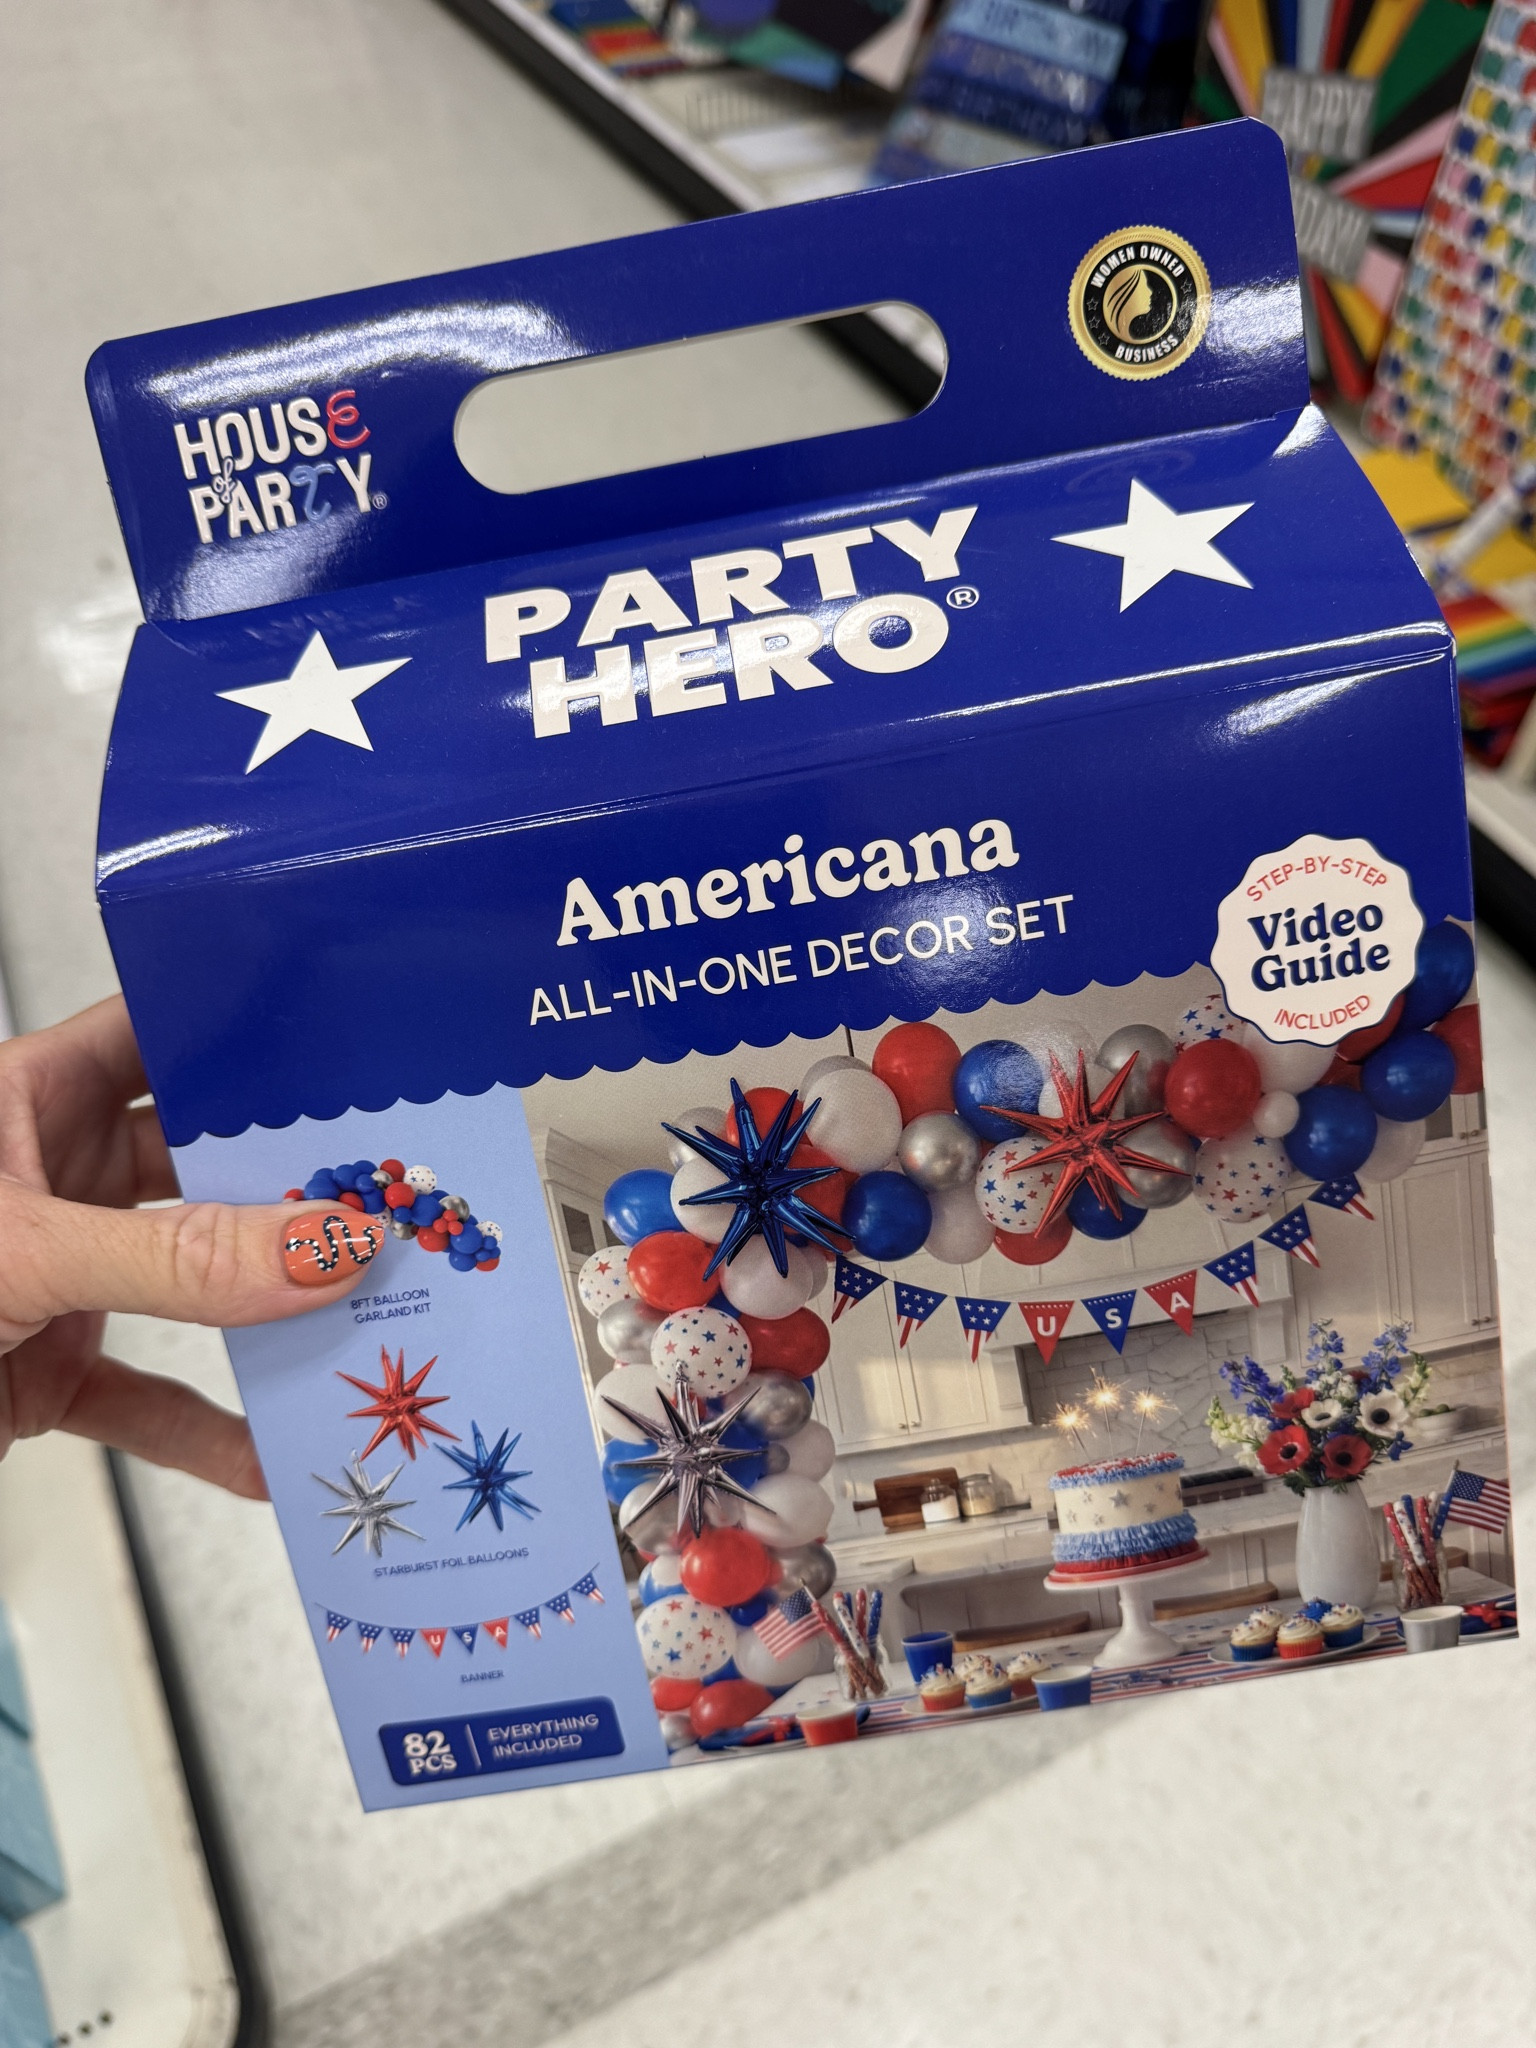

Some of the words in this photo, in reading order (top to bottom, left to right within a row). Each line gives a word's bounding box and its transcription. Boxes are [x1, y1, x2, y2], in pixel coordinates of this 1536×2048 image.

[1090, 245, 1136, 289] WOMEN
[1139, 244, 1186, 279] OWNED
[1114, 334, 1180, 363] BUSINESS
[174, 388, 371, 480] HOUSE
[212, 456, 236, 504] of
[485, 504, 979, 664] PARTY
[556, 818, 1020, 947] Americana
[1246, 855, 1388, 902] STEP-BY-STEP
[1247, 901, 1384, 951] Video
[529, 944, 798, 1026] ALL-IN-ONE
[808, 914, 973, 979] DECOR
[986, 894, 1075, 947] SET
[1251, 937, 1391, 993] Guide
[1274, 994, 1371, 1030] INCLUDED
[350, 1297, 371, 1310] 8FT
[373, 1288, 430, 1306] BALLOON
[354, 1305, 412, 1324] GARLAND
[414, 1301, 432, 1314] KIT
[374, 1560, 440, 1578] STARBURST
[441, 1557, 468, 1569] FOIL
[468, 1547, 530, 1565] BALLOONS
[460, 1669, 505, 1684] BANNER
[403, 1730, 451, 1758] 82
[487, 1713, 600, 1742] EVERYTHING
[493, 1733, 583, 1758] INCLUDED
[410, 1753, 458, 1775] PCS
